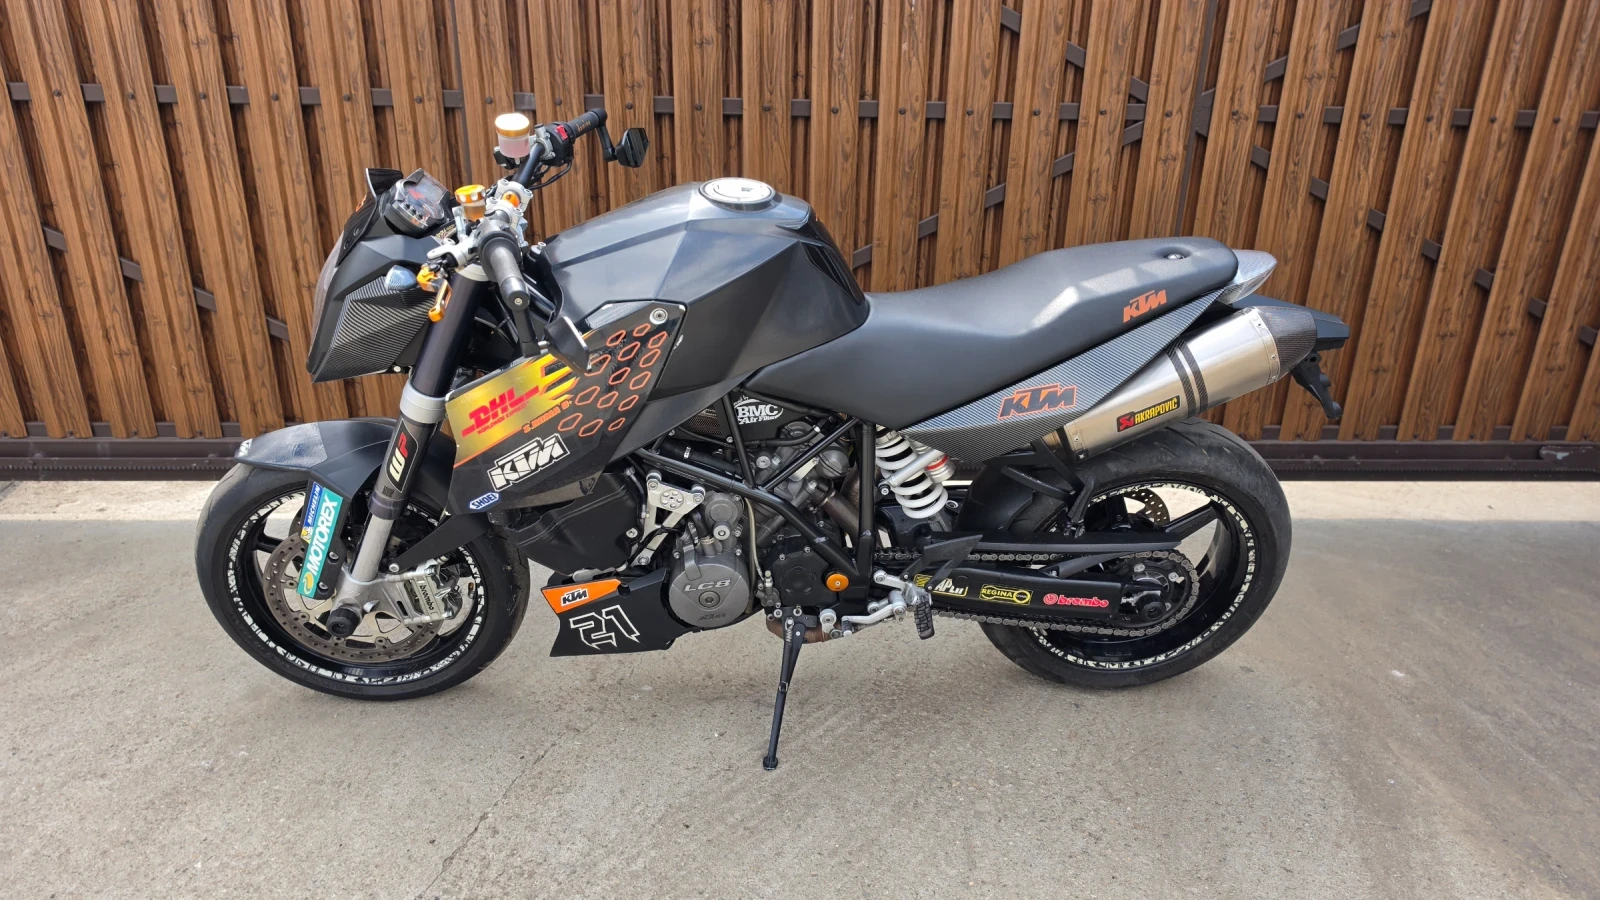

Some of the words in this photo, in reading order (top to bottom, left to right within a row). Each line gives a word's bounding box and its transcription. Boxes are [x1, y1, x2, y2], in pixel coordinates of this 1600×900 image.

[1123, 290, 1167, 323] KTM
[466, 387, 530, 431] DHL
[737, 404, 778, 418] BMC
[998, 383, 1077, 420] KTM
[738, 416, 758, 425] Air
[488, 435, 568, 490] KTM
[307, 484, 321, 525] MICHELIN
[471, 493, 498, 507] SHOEI
[306, 493, 338, 576] MOTOREX
[419, 584, 435, 611] brembo
[562, 589, 588, 605] KTM
[684, 579, 731, 592] LC8
[981, 588, 1013, 598] REGINA
[1057, 594, 1109, 608] brembo
[569, 604, 640, 650] 21
